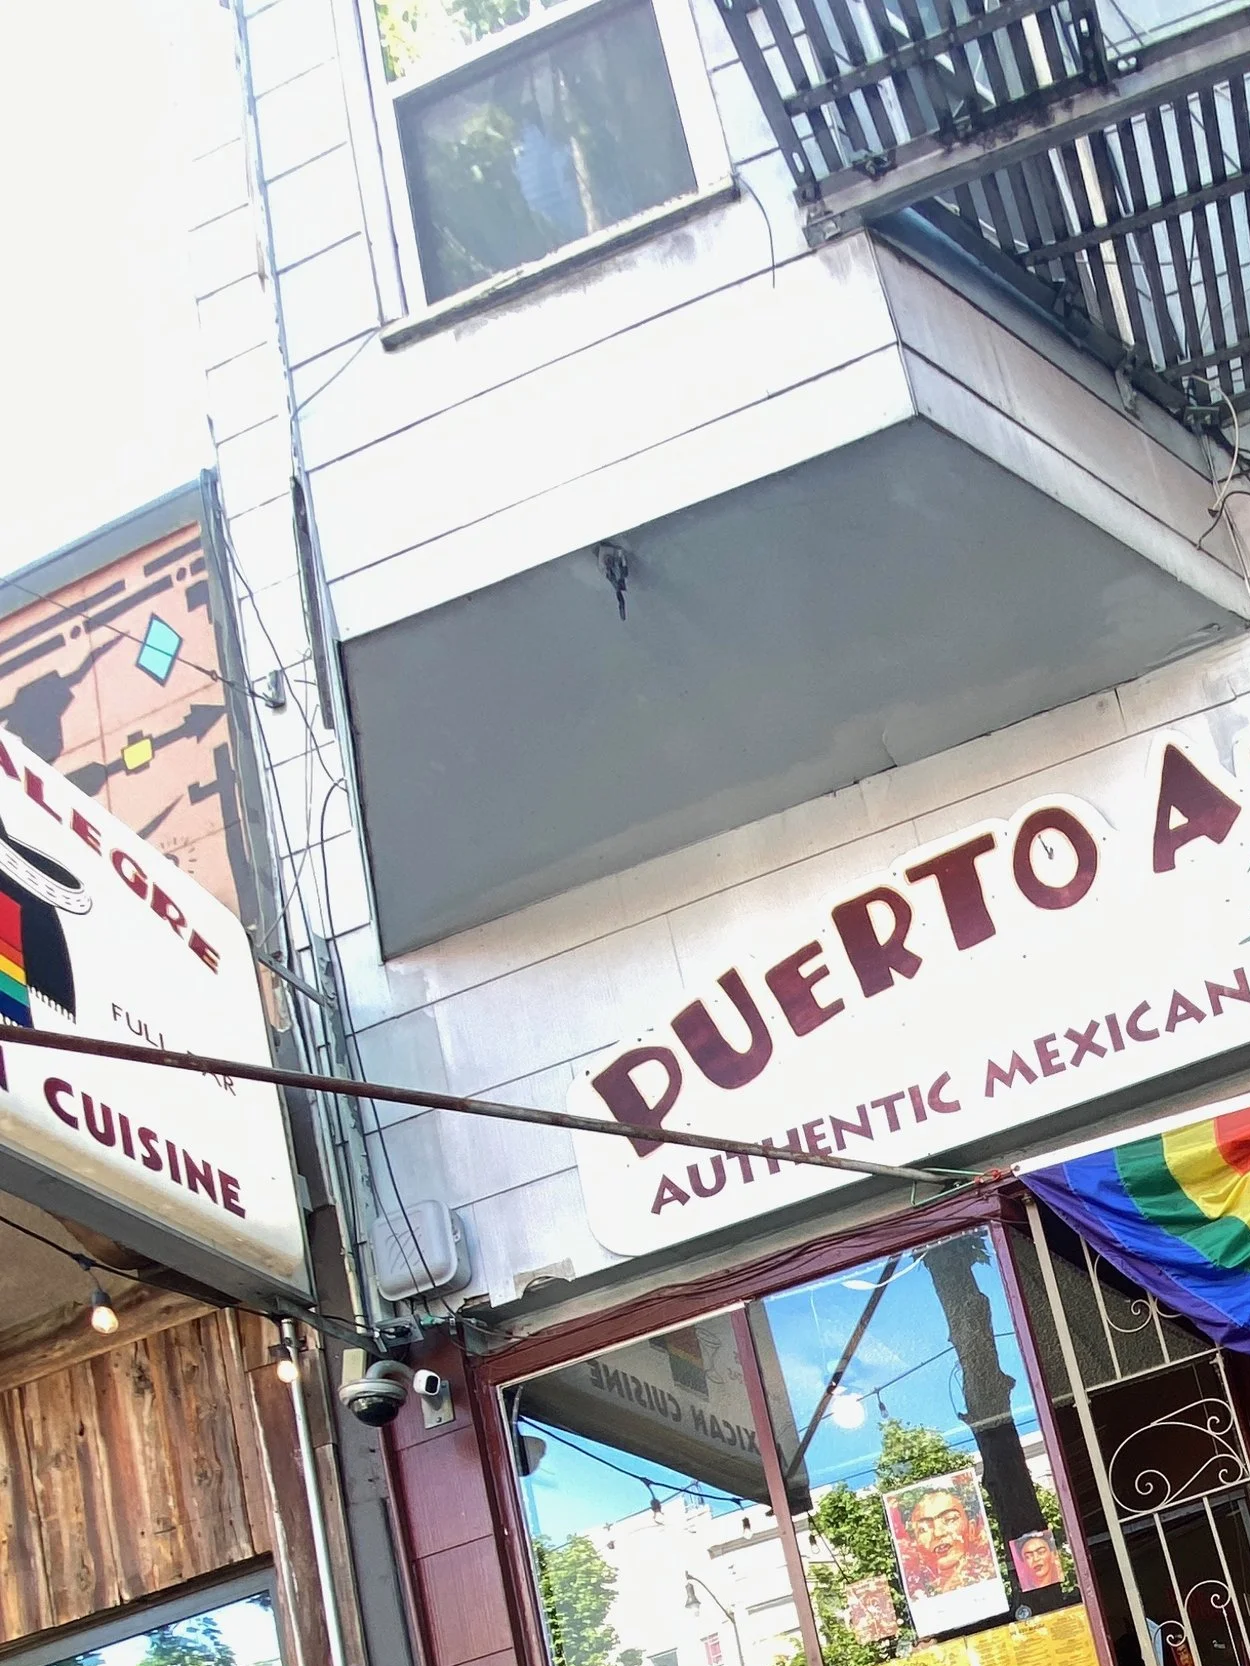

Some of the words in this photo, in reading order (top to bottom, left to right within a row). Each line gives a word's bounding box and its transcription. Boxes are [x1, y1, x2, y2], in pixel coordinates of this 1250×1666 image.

[591, 808, 1098, 1159] PUERTO
[44, 1077, 247, 1219] CUISINE
[651, 1071, 961, 1215] AUTHENTIC
